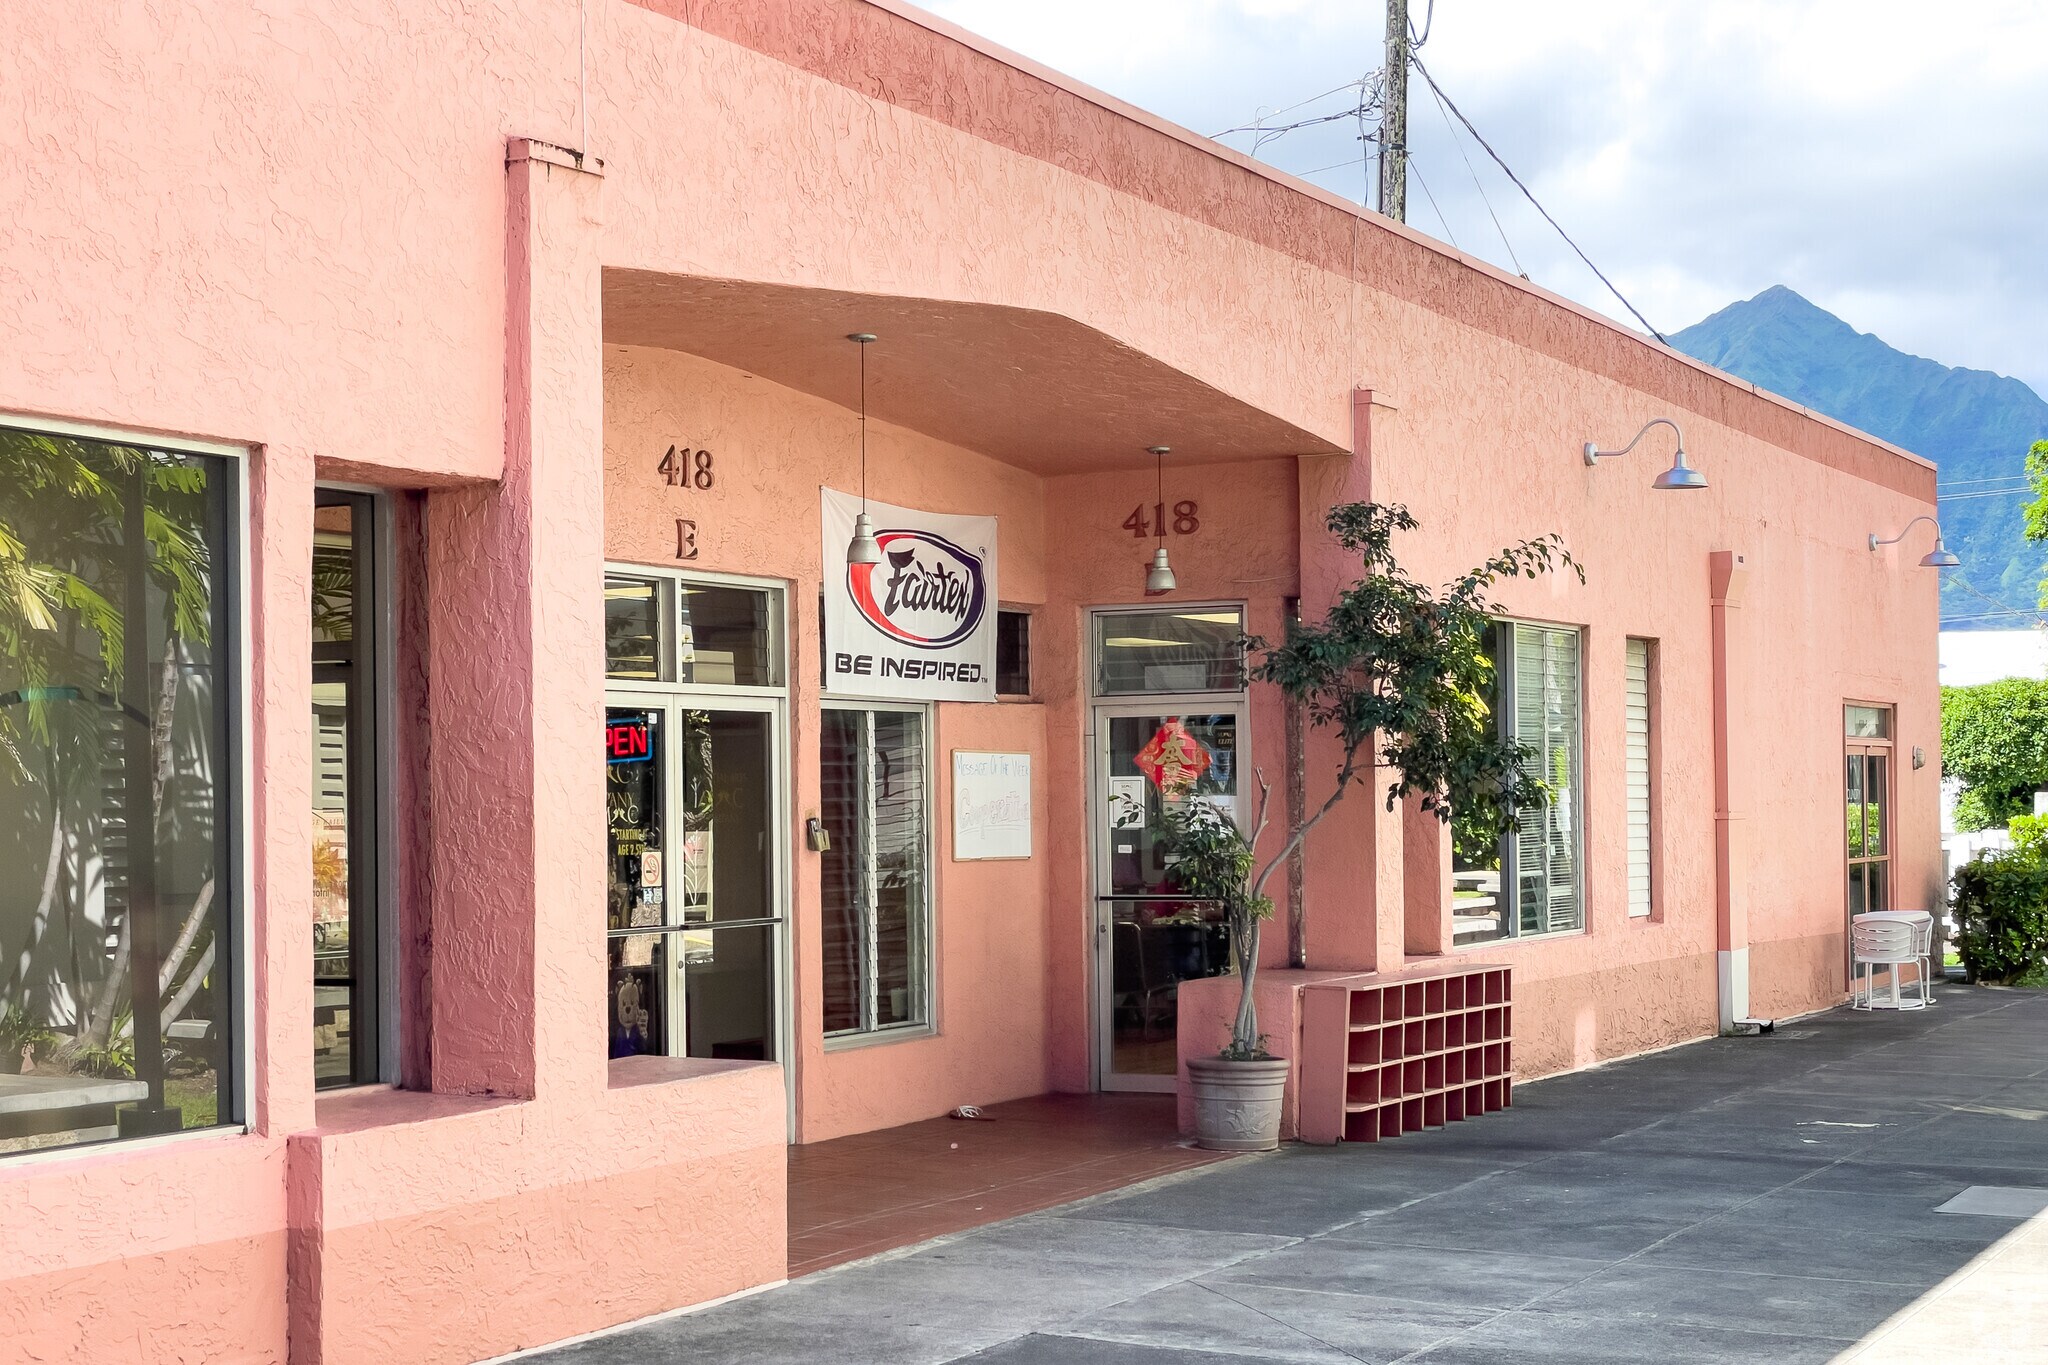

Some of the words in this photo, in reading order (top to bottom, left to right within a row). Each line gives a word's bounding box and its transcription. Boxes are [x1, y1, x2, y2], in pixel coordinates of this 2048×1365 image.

[658, 444, 715, 491] 418
[676, 518, 699, 560] E
[1122, 500, 1199, 538] 418
[884, 547, 970, 622] Fairtex
[835, 652, 873, 676] BE
[880, 656, 981, 683] INSPIRED
[617, 844, 629, 856] AGE
